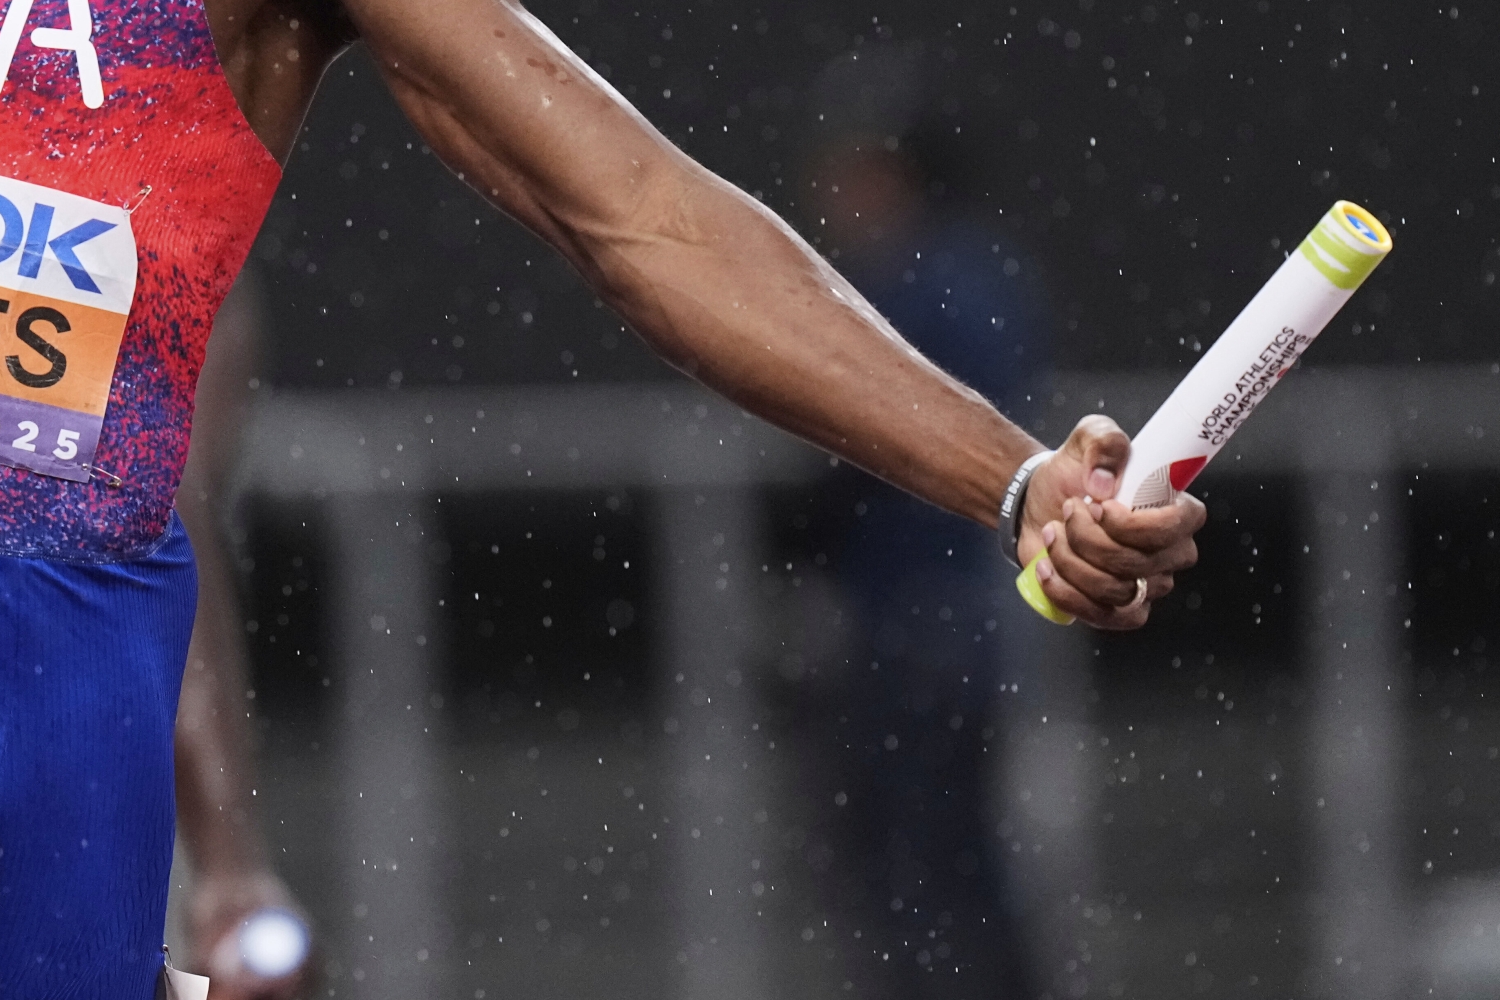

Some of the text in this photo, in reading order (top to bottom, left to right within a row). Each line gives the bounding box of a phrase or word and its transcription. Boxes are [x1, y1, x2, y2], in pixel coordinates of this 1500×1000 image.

[1198, 393, 1237, 441] WORLD
[1235, 326, 1295, 393] ATHLETICS
[1211, 334, 1307, 446] CHAMPIONSHIPS
[1008, 481, 1020, 495] Do
